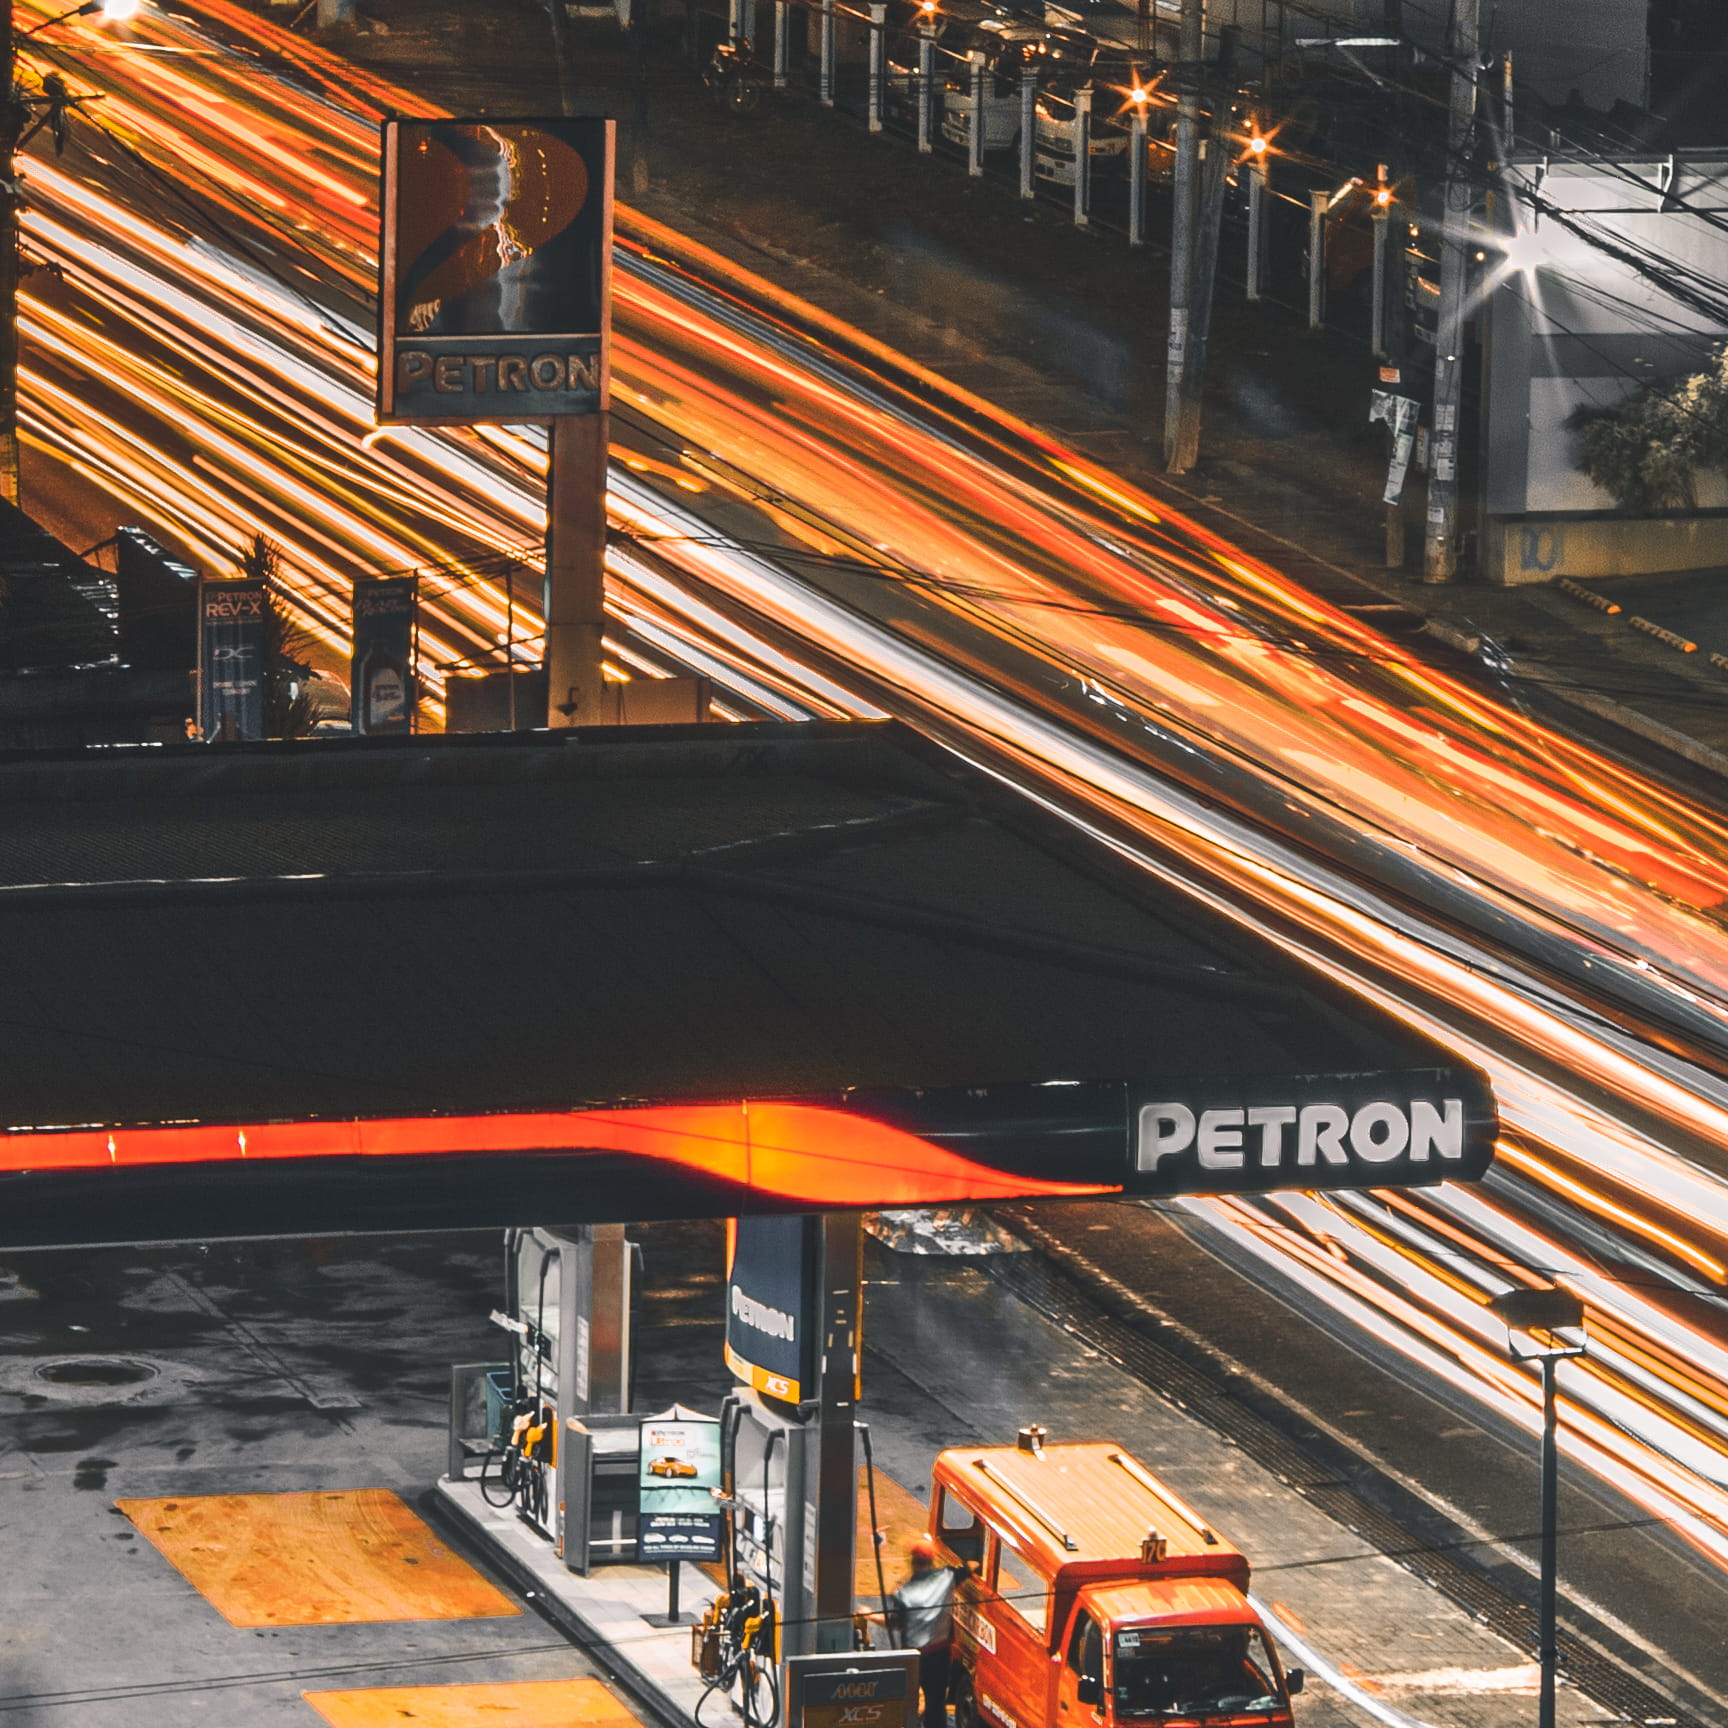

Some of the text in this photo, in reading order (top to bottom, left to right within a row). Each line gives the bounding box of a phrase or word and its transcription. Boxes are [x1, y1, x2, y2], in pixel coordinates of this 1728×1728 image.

[397, 350, 600, 393] PETRON
[206, 602, 262, 618] REV-X
[1137, 1098, 1463, 1172] PETRON
